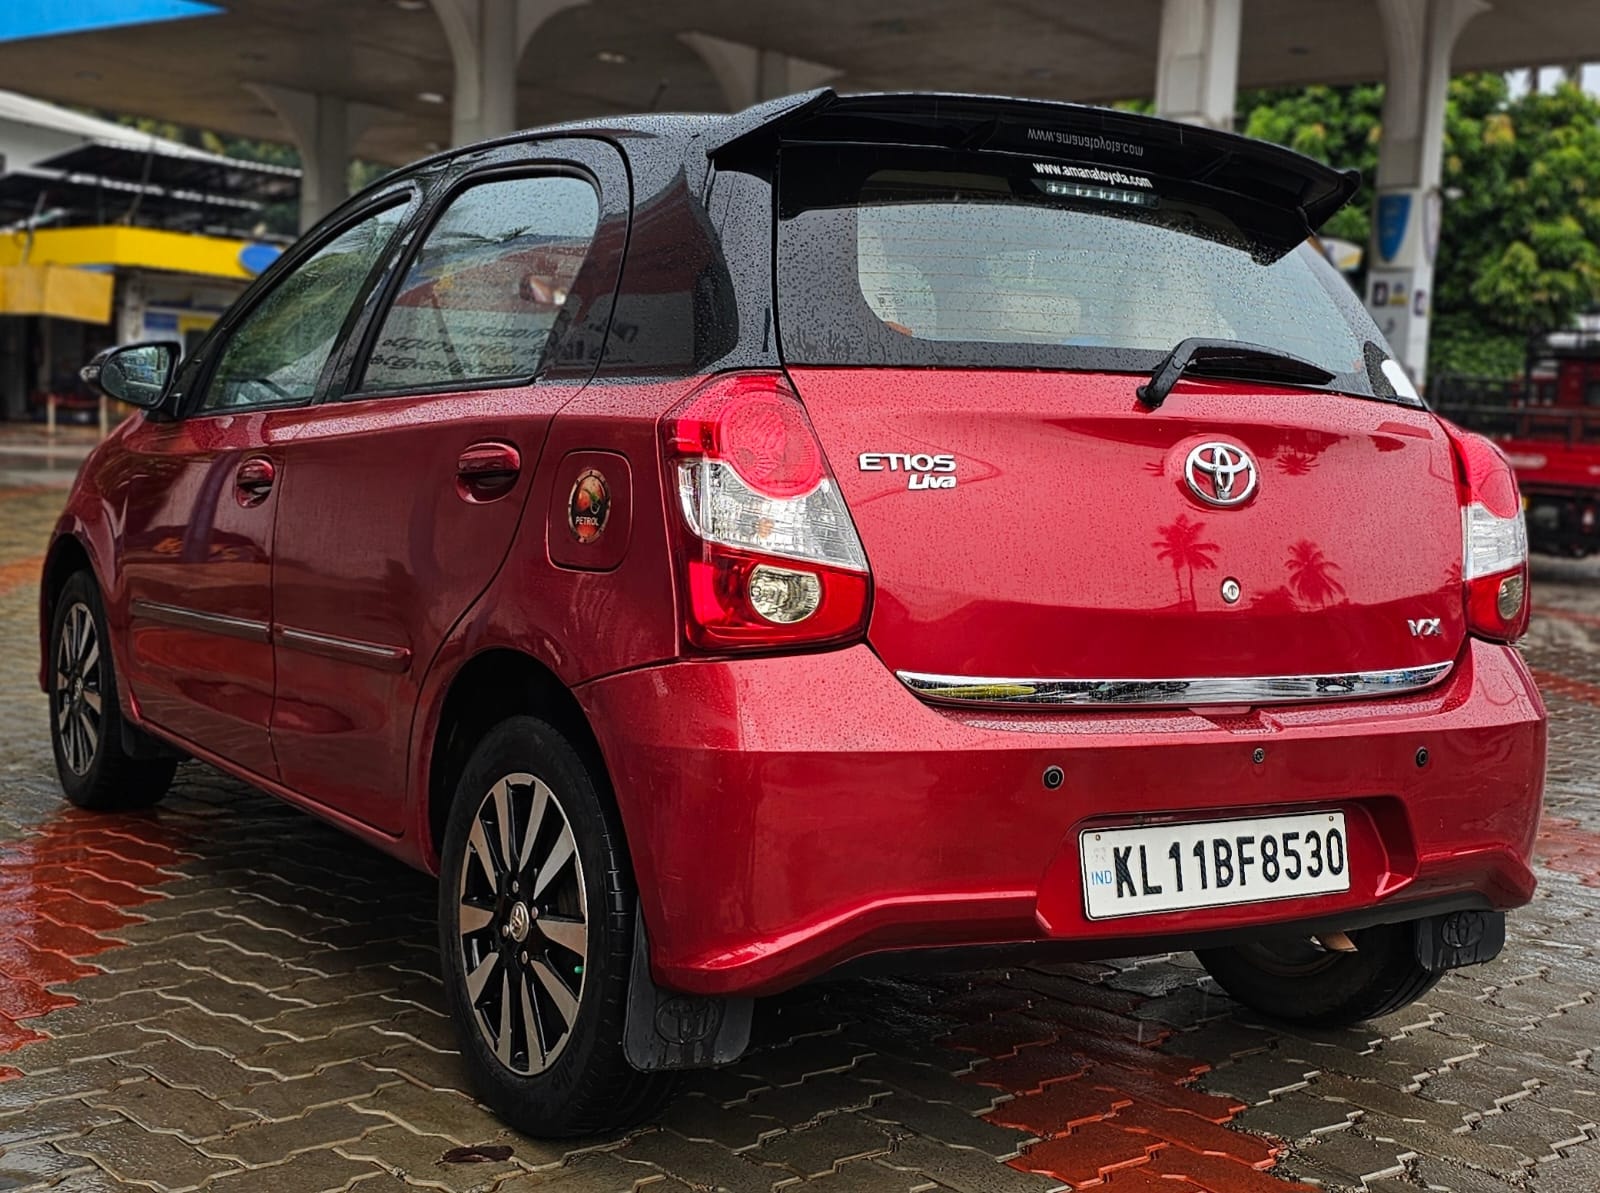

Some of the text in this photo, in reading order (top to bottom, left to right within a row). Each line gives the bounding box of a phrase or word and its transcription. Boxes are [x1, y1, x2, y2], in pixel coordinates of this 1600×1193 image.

[1033, 163, 1153, 188] www.amanatoyota.com
[858, 452, 957, 473] ETIOS
[907, 473, 957, 490] Liva
[575, 516, 599, 526] PETROL
[1407, 617, 1442, 637] VX
[1113, 827, 1344, 898] KL11BF8530
[1091, 870, 1113, 886] IND
